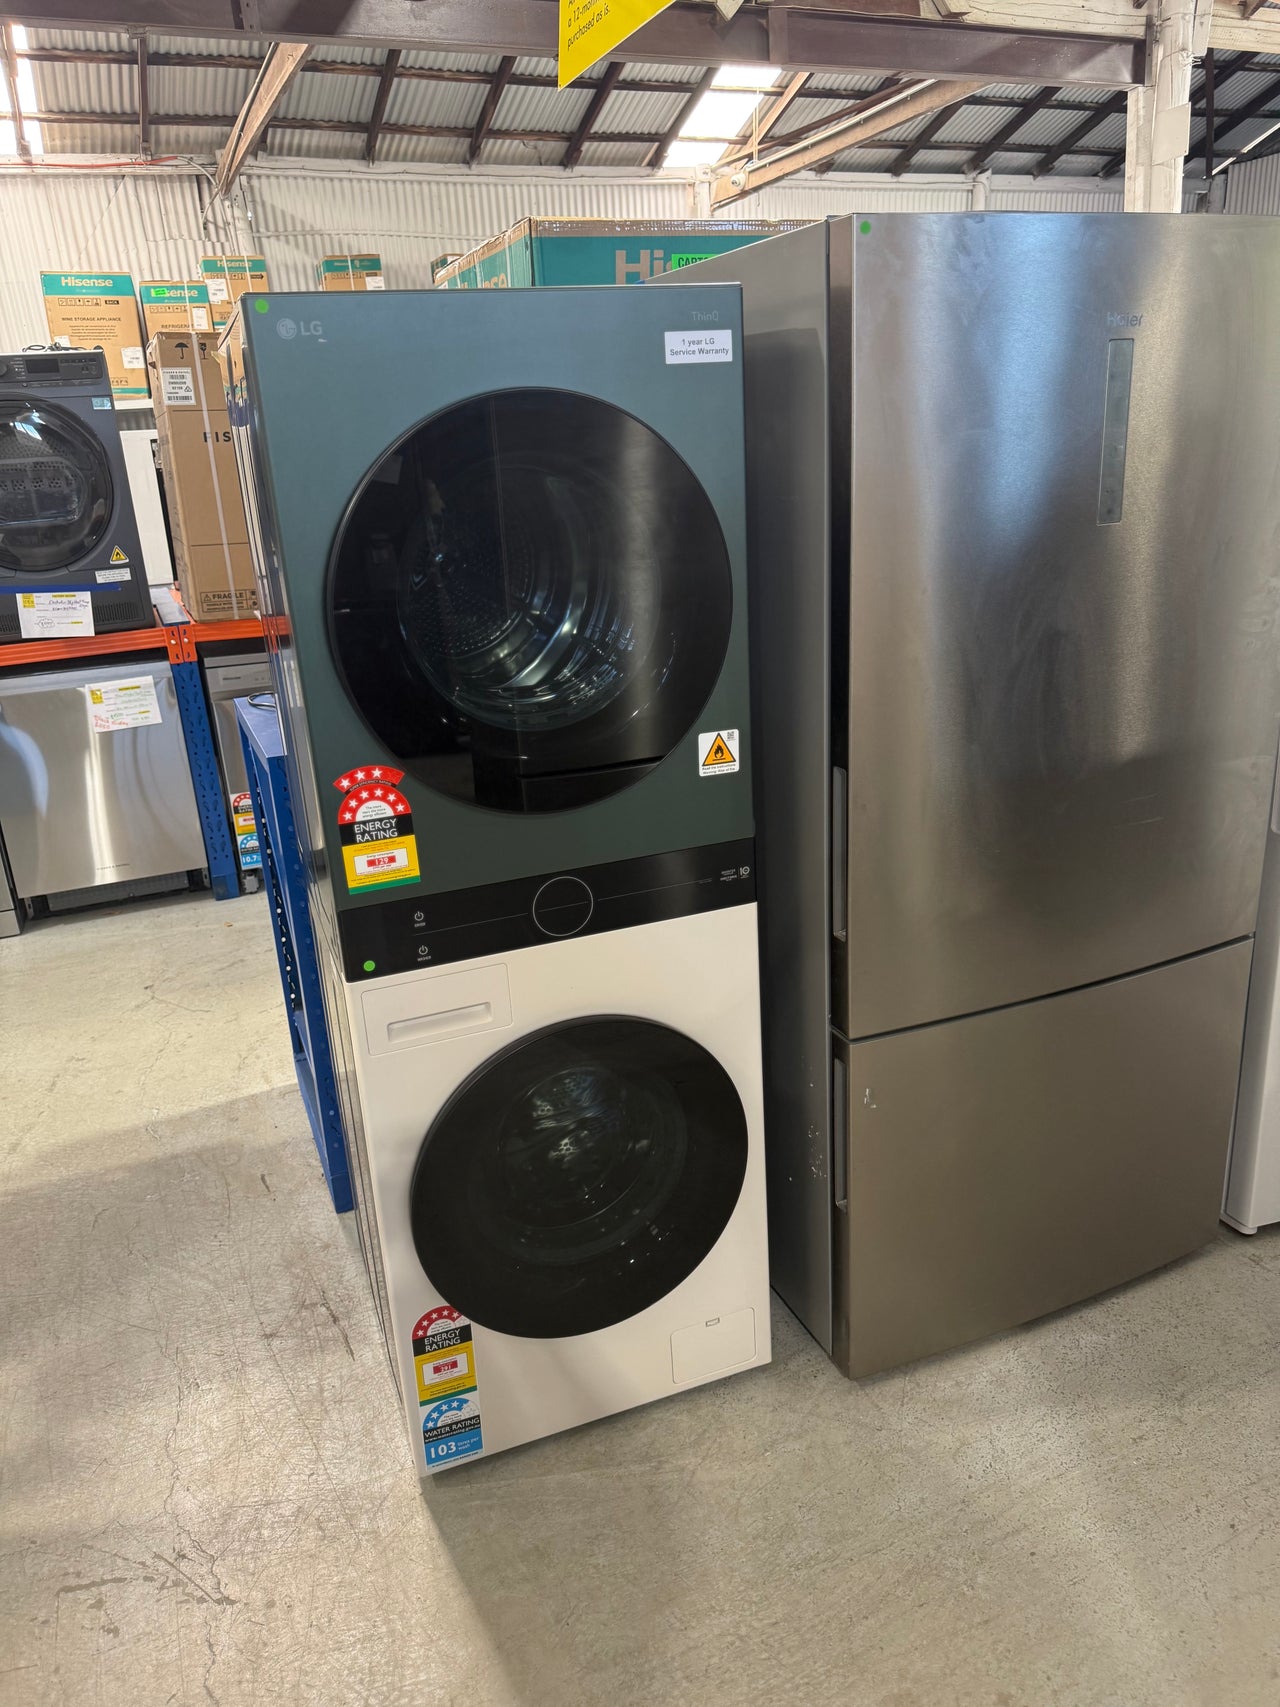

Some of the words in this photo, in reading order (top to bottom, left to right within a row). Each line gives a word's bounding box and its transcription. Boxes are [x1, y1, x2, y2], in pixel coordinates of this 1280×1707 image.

[567, 12, 595, 51] purchased
[596, 10, 603, 23] as
[60, 276, 113, 287] Hisense
[691, 310, 720, 322] ThinQ
[1106, 311, 1144, 327] Haier
[300, 320, 323, 336] LG
[682, 338, 686, 346] 1
[687, 339, 703, 348] year
[669, 348, 696, 356] Service
[697, 347, 730, 356] Warranty
[354, 818, 397, 834] ENERGY
[356, 829, 398, 843] RATING
[242, 855, 257, 863] 10.7
[375, 857, 389, 866] 129
[424, 1328, 461, 1346] ENERGY
[425, 1337, 461, 1353] RATING
[424, 1426, 451, 1438] WATER
[452, 1417, 480, 1430] RATING
[430, 1441, 457, 1459] 103
